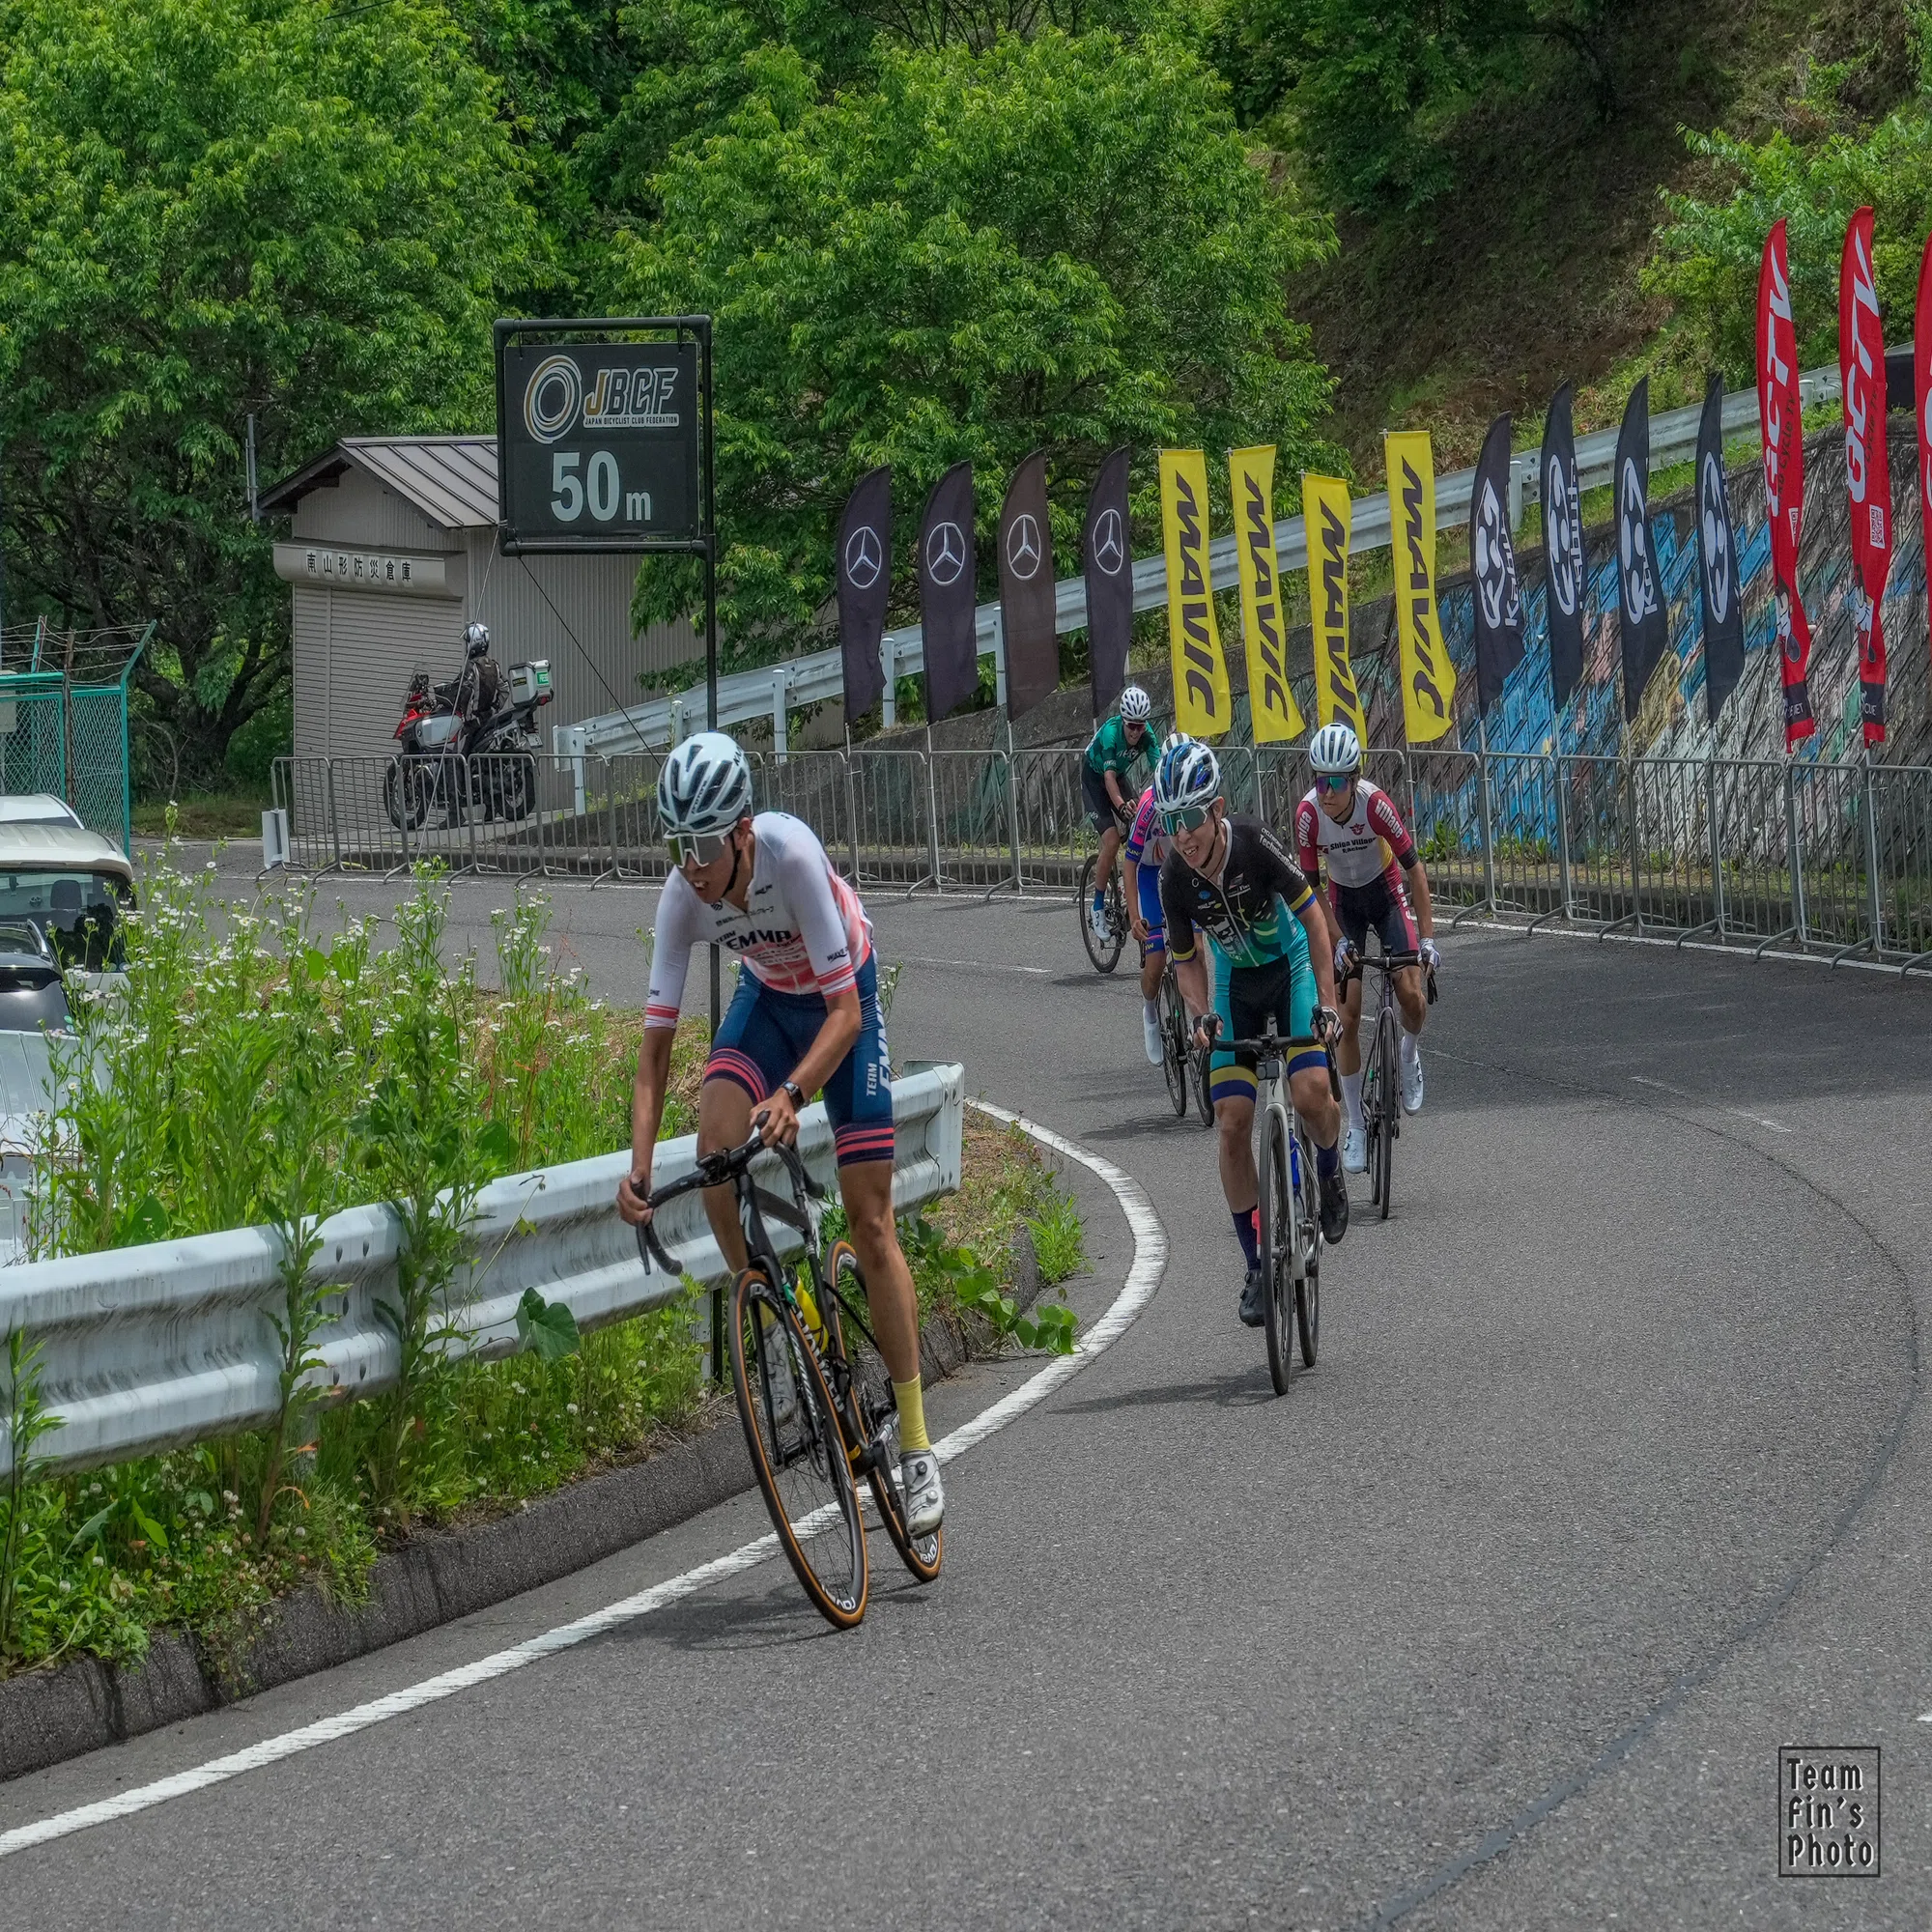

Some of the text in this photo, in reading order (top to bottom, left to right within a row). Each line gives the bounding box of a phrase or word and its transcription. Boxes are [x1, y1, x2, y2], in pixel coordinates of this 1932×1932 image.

[583, 368, 678, 415] JBCF
[584, 415, 677, 425] JAPAN BICYCLIST CLUB FEDERATION
[551, 450, 651, 522] 50 m
[1176, 469, 1215, 718] MAVIC
[1244, 469, 1289, 722] MAVIC
[1401, 455, 1444, 718] MAVIC
[1375, 798, 1404, 838] Village
